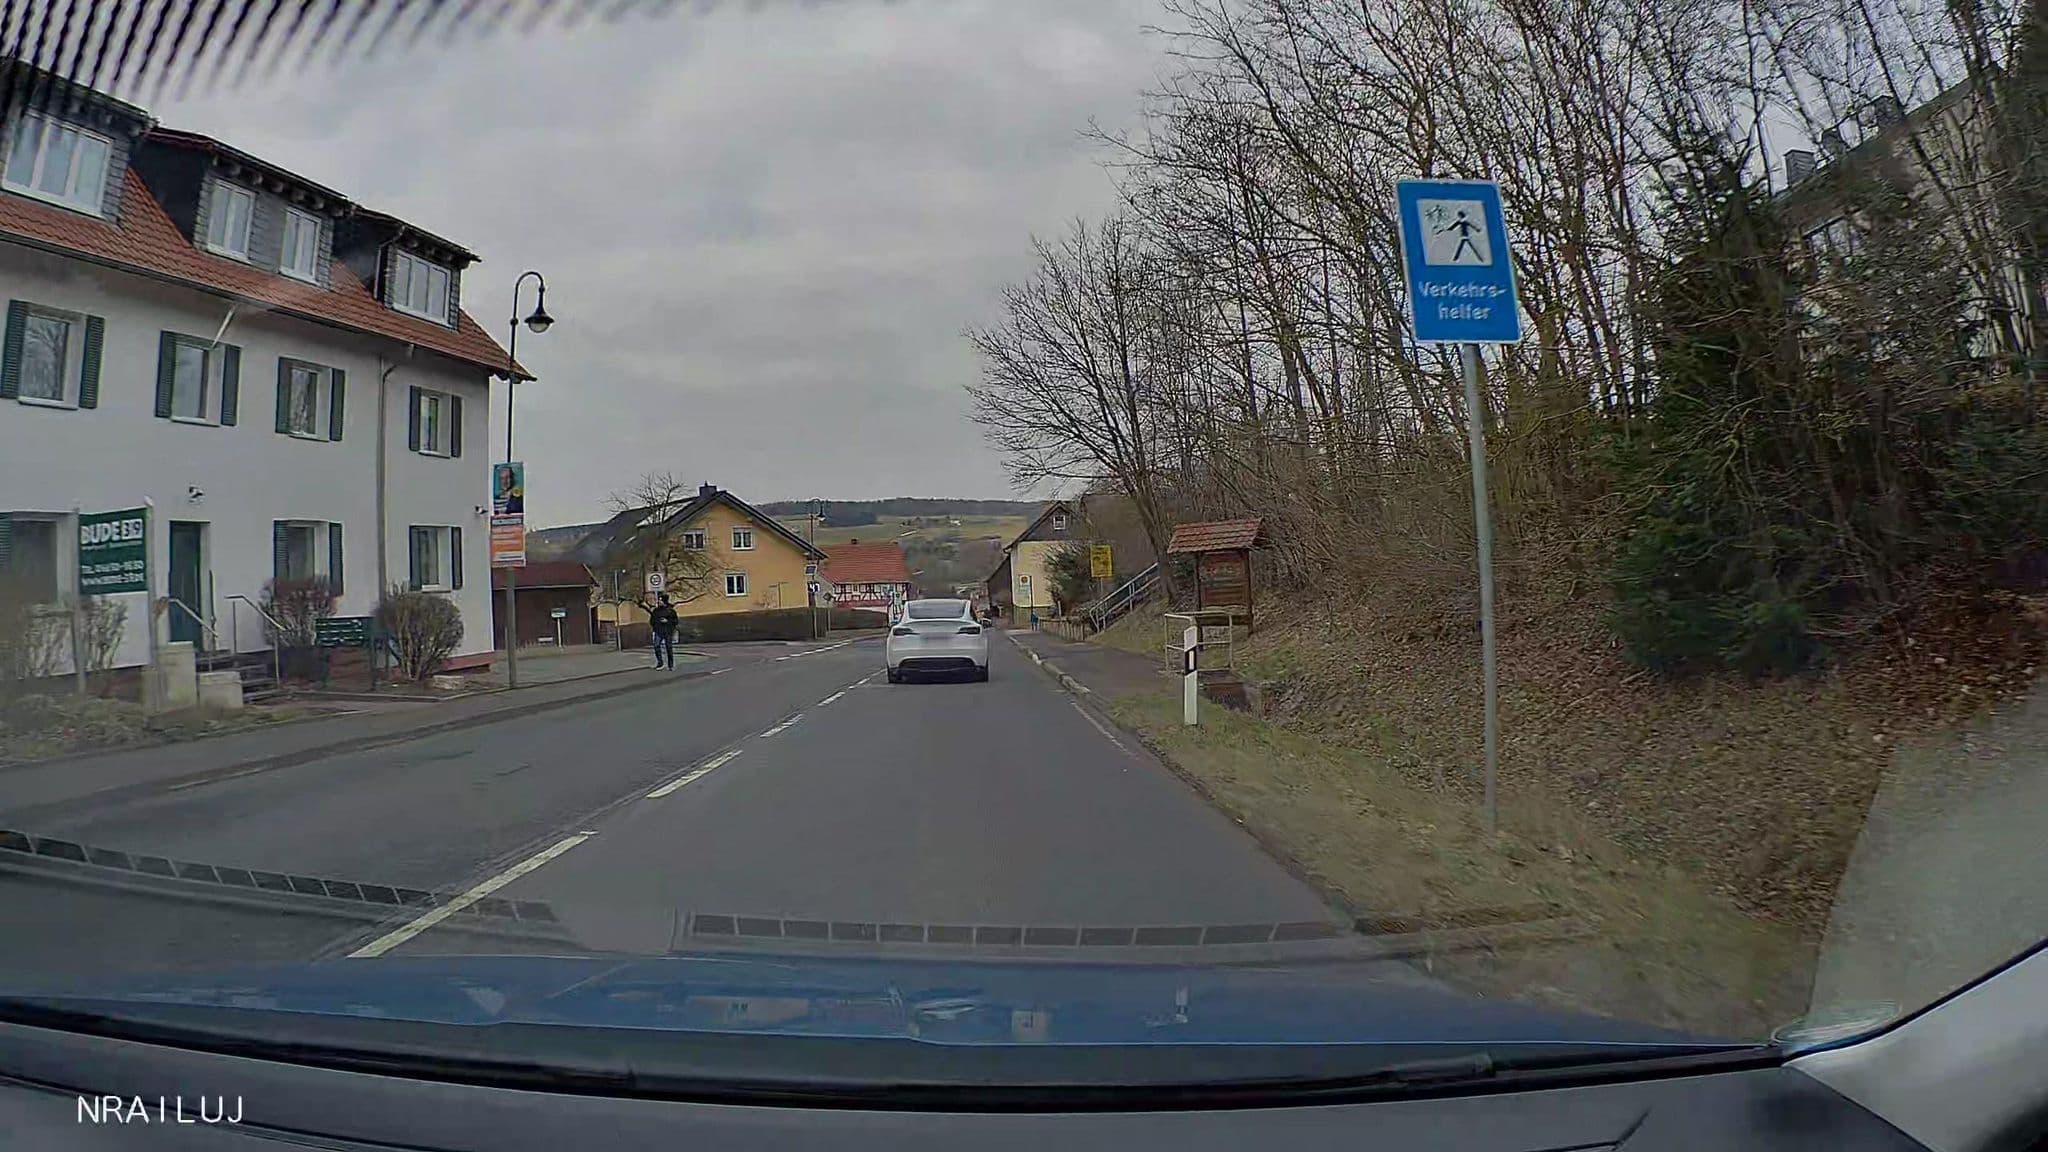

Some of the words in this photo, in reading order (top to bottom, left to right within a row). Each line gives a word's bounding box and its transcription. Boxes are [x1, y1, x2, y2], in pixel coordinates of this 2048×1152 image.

[1418, 281, 1508, 298] Verkehrs-
[1438, 302, 1492, 320] helfer
[80, 521, 121, 545] BUDE
